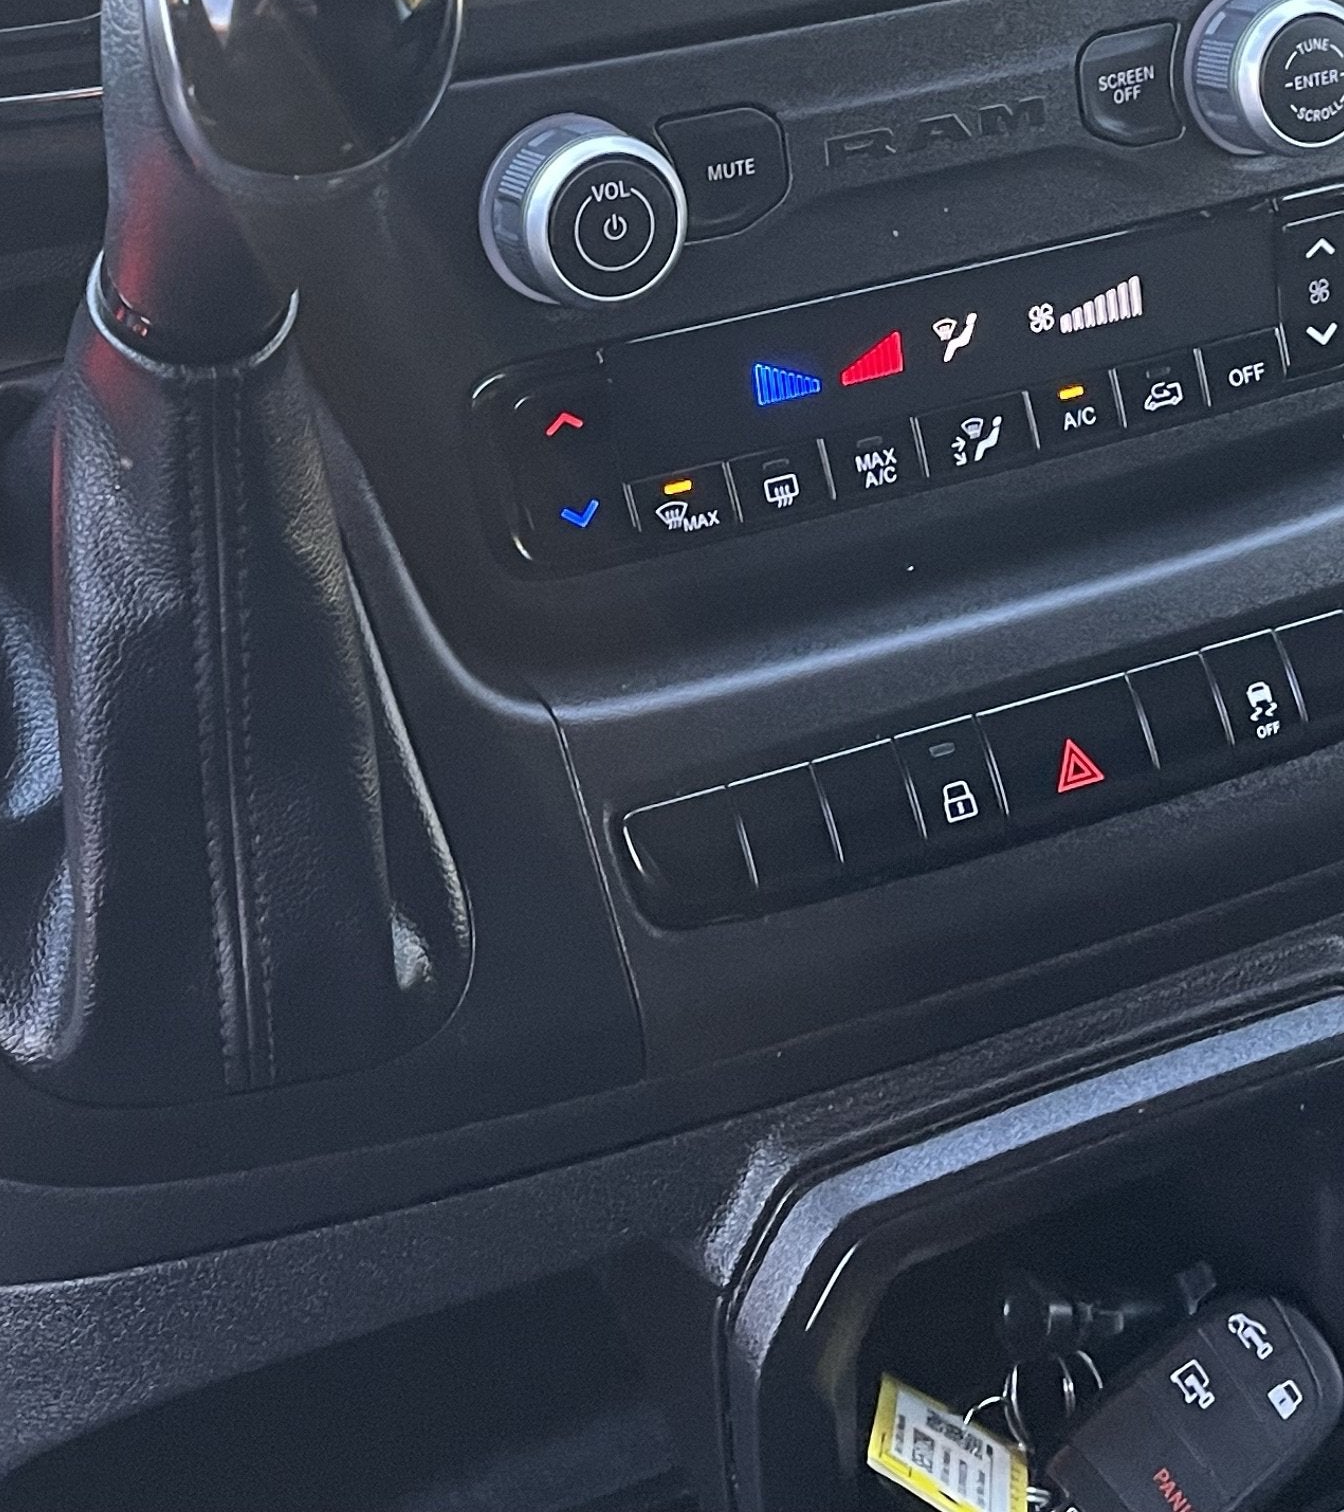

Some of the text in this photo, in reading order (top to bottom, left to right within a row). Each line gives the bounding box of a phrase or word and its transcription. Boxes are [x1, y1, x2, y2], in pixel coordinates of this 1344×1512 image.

[1296, 38, 1331, 56] TUNE
[1098, 65, 1155, 92] SCREEN
[1294, 69, 1340, 90] ENTER
[1113, 84, 1142, 105] OFF
[1296, 100, 1343, 123] SCROLL
[707, 157, 757, 181] MUTE
[590, 181, 631, 202] VOL
[1228, 361, 1266, 387] OFF
[1063, 406, 1097, 430] A/C
[856, 447, 898, 472] MAX
[864, 465, 898, 488] A/C
[683, 509, 721, 532] MAX
[1256, 720, 1281, 740] OFF
